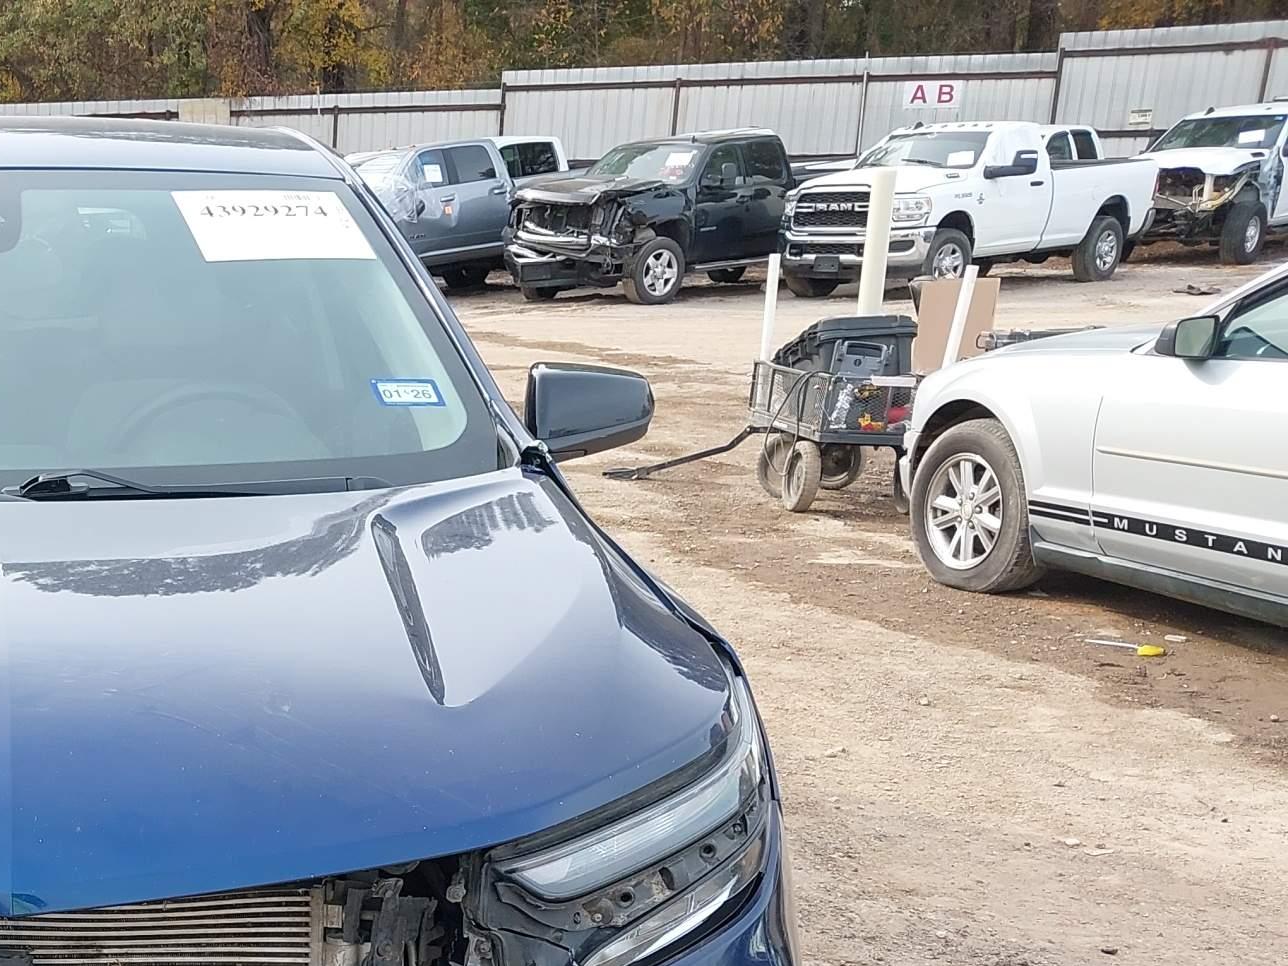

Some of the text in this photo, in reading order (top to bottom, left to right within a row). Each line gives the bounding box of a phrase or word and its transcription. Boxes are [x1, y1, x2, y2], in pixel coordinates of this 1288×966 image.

[200, 204, 328, 218] 43929274
[814, 202, 853, 212] RAM
[1113, 516, 1283, 562] MUSTAN
